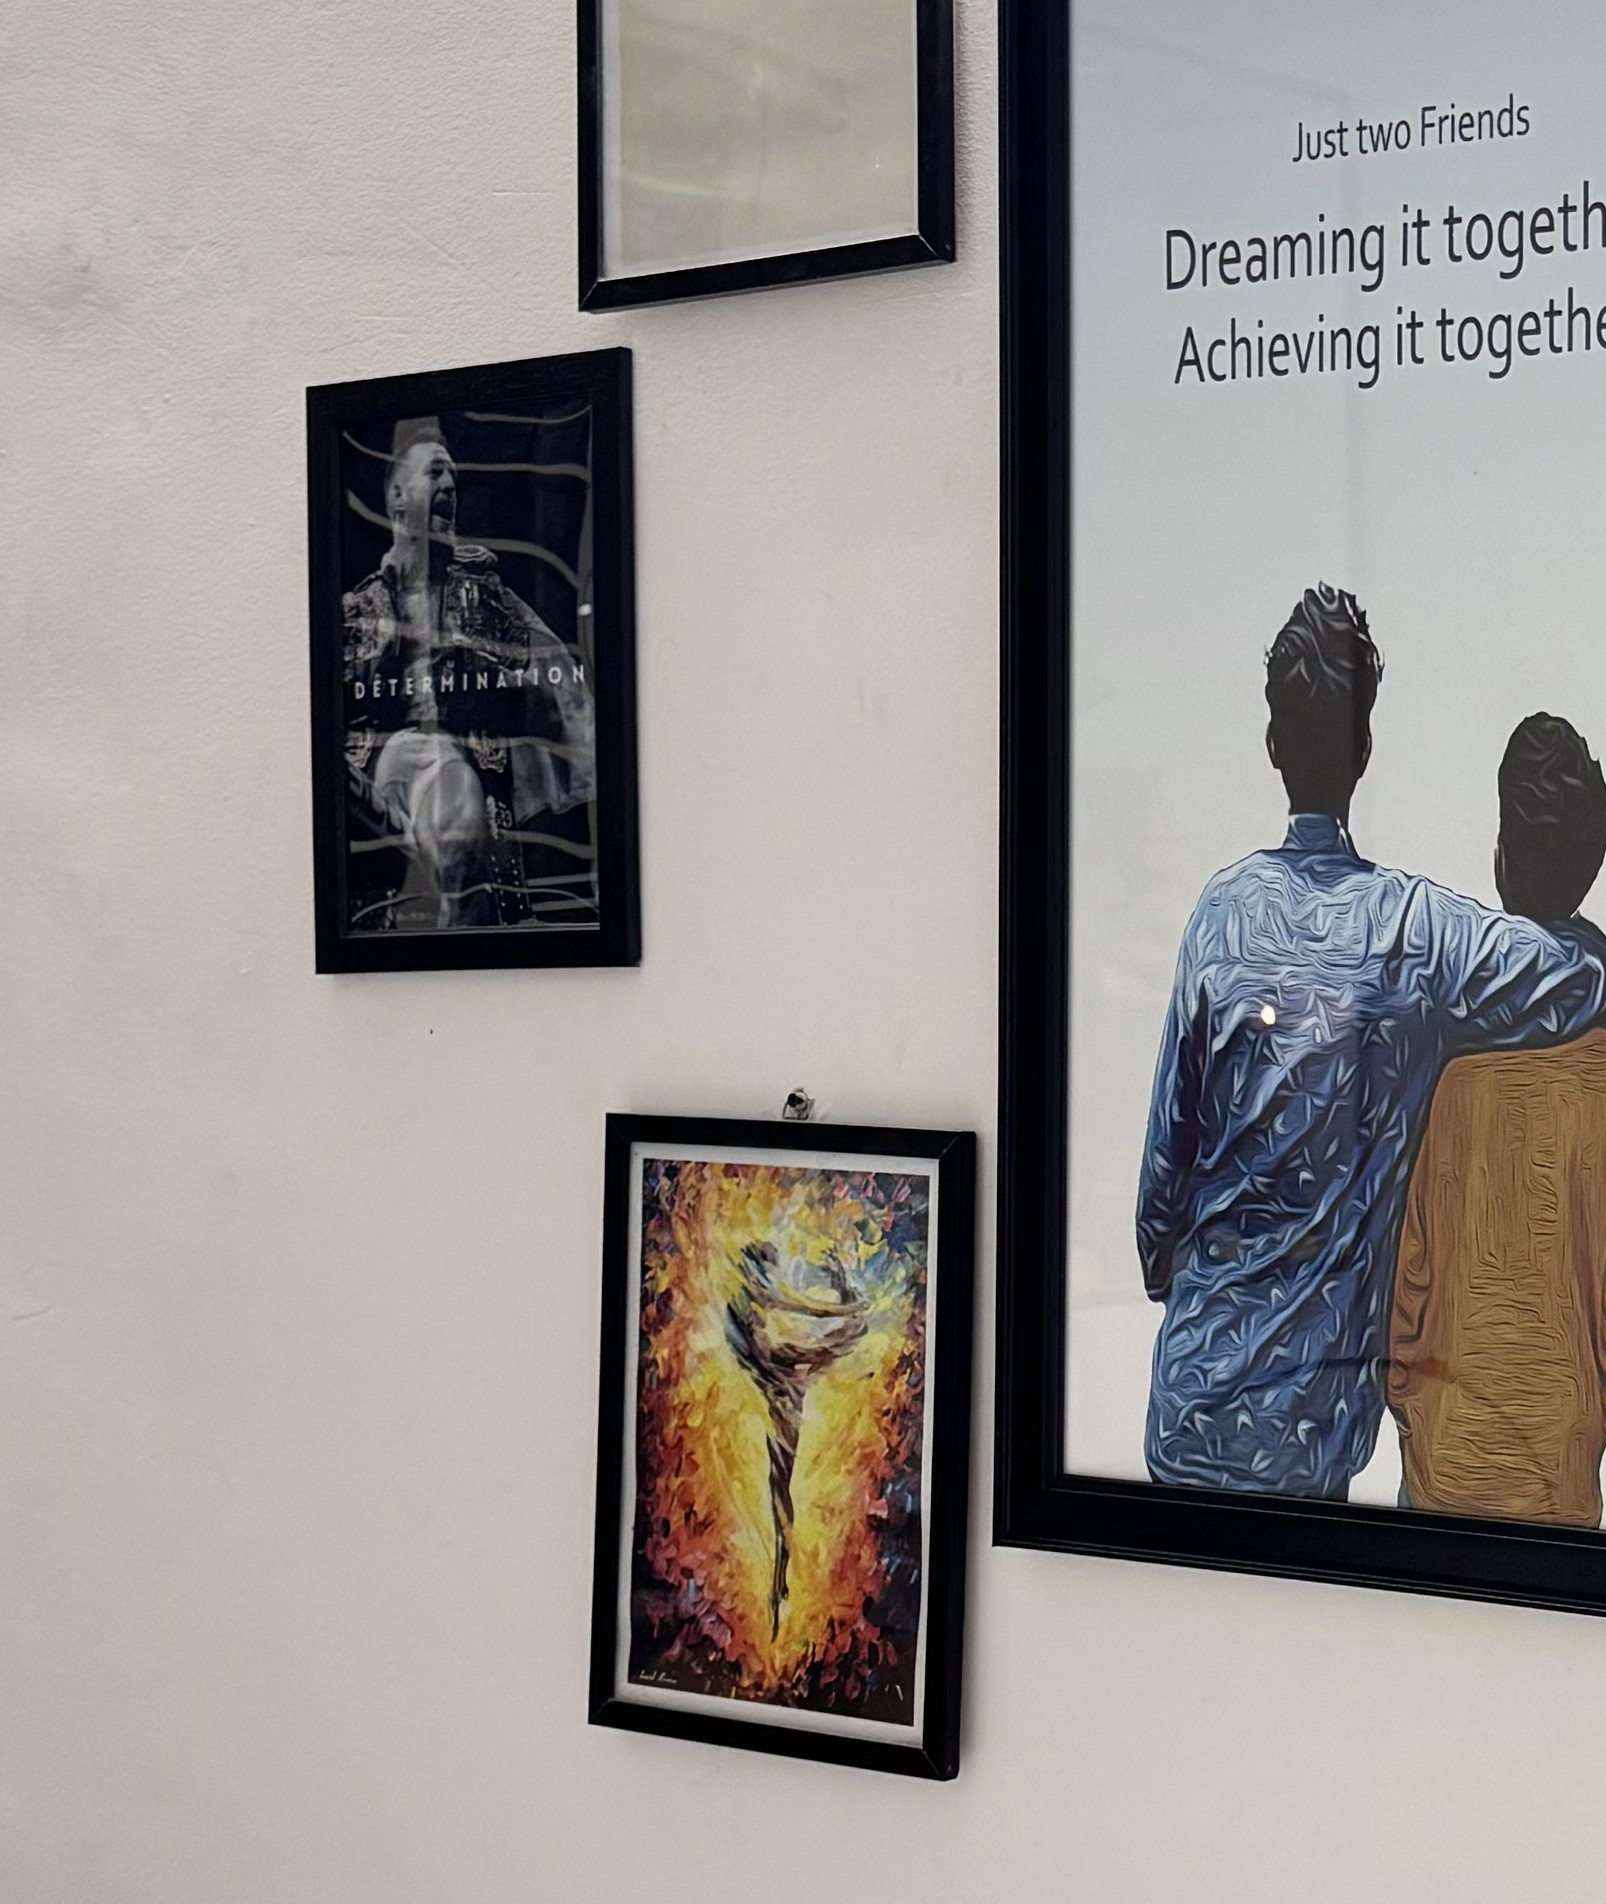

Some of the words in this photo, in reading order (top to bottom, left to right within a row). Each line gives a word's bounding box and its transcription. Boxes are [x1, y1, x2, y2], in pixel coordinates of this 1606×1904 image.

[1292, 121, 1349, 163] Just
[1355, 118, 1411, 155] two
[1421, 92, 1531, 148] Friends
[1165, 213, 1386, 293] Dreaming
[1401, 203, 1431, 267] it
[1174, 313, 1381, 390] Achieving
[1396, 306, 1425, 367] it
[354, 664, 586, 700] DETERMINATION
